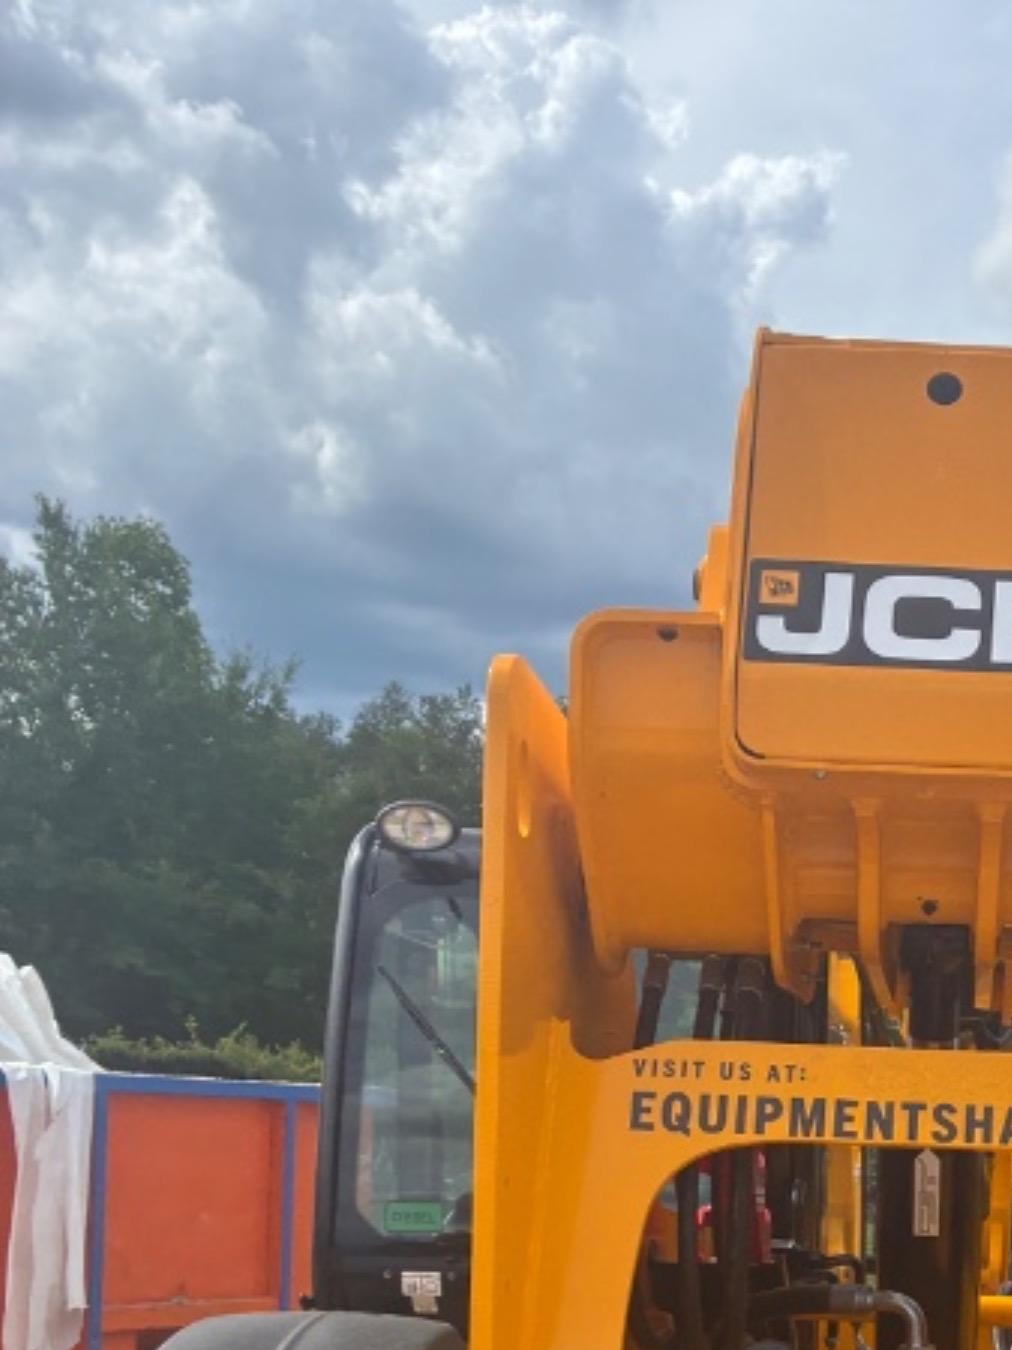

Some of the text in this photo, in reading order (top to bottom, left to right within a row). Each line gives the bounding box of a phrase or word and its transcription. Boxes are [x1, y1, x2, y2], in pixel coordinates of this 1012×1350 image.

[633, 1058, 807, 1084] VISIT US AT:
